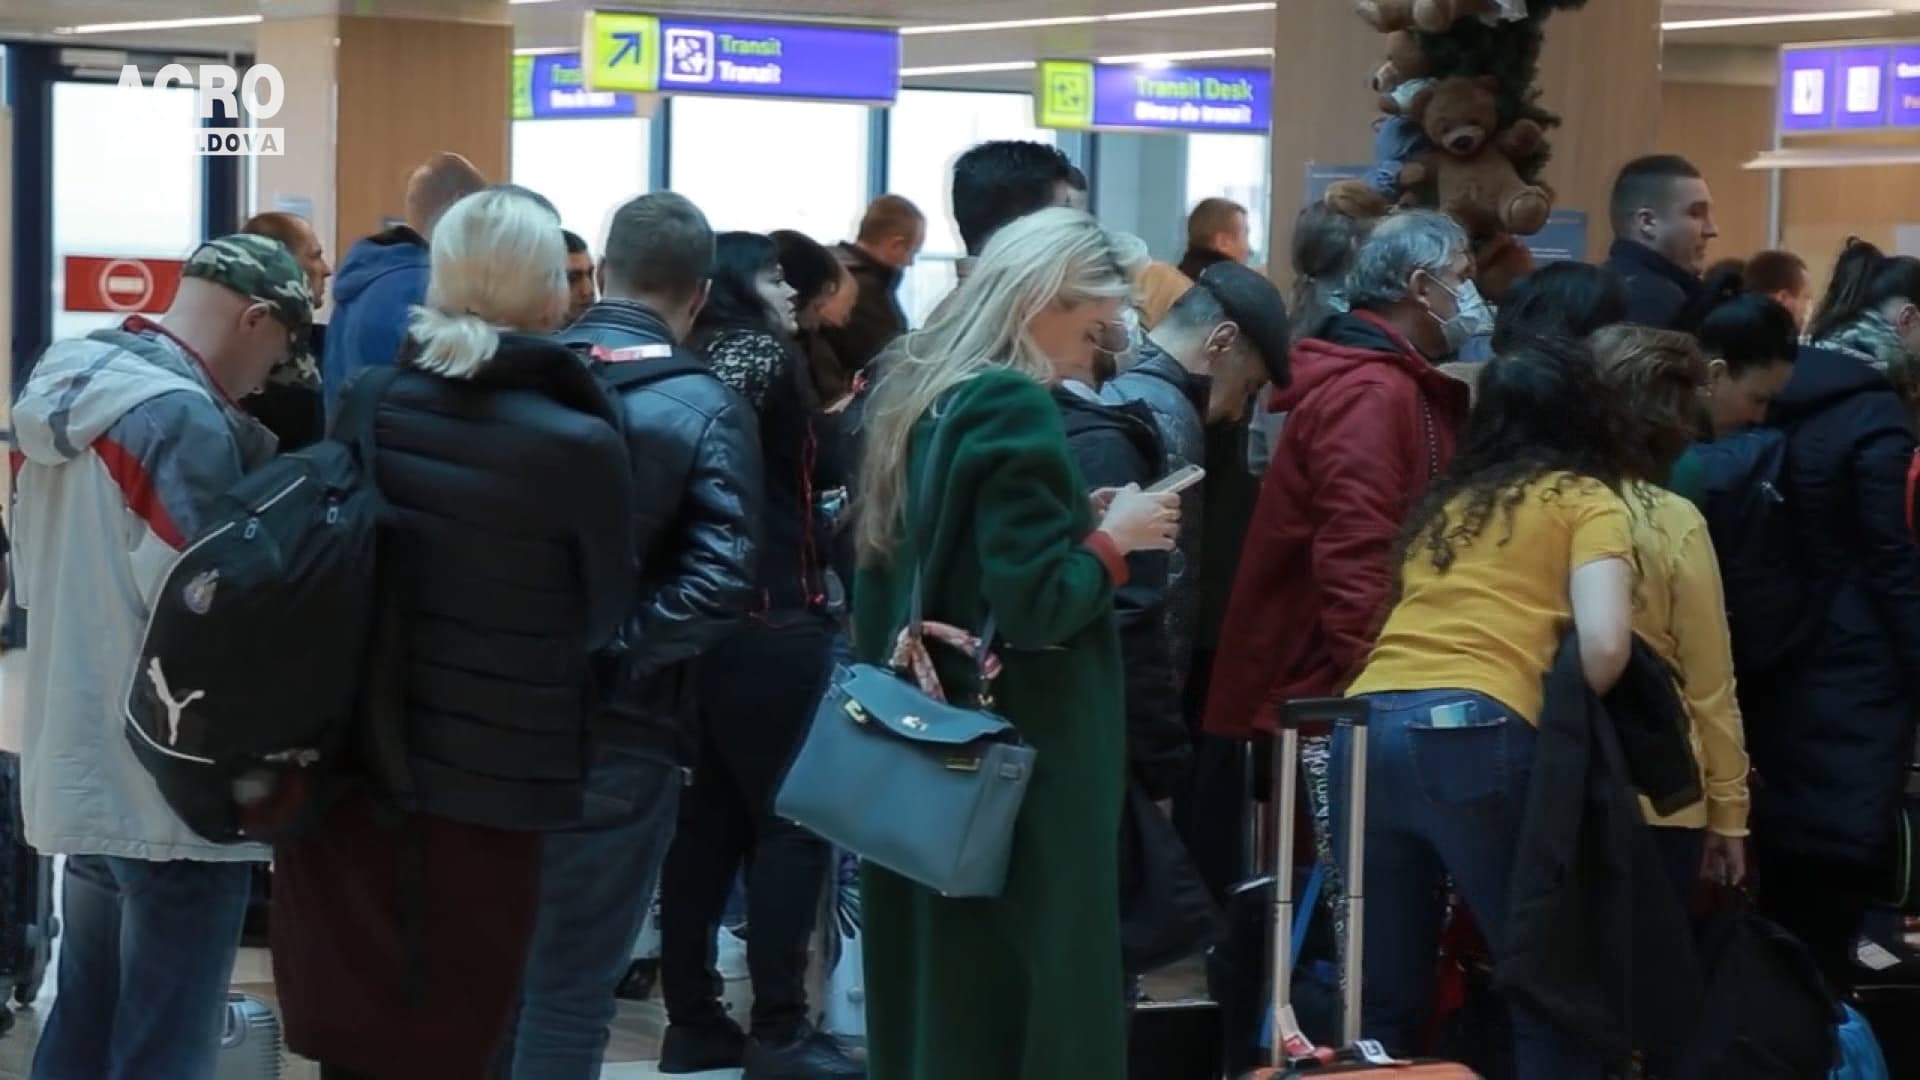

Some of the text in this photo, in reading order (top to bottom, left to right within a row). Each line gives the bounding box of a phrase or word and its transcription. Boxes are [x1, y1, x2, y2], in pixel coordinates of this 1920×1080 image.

[718, 34, 782, 56] Transit
[1136, 75, 1253, 101] Transit Desk
